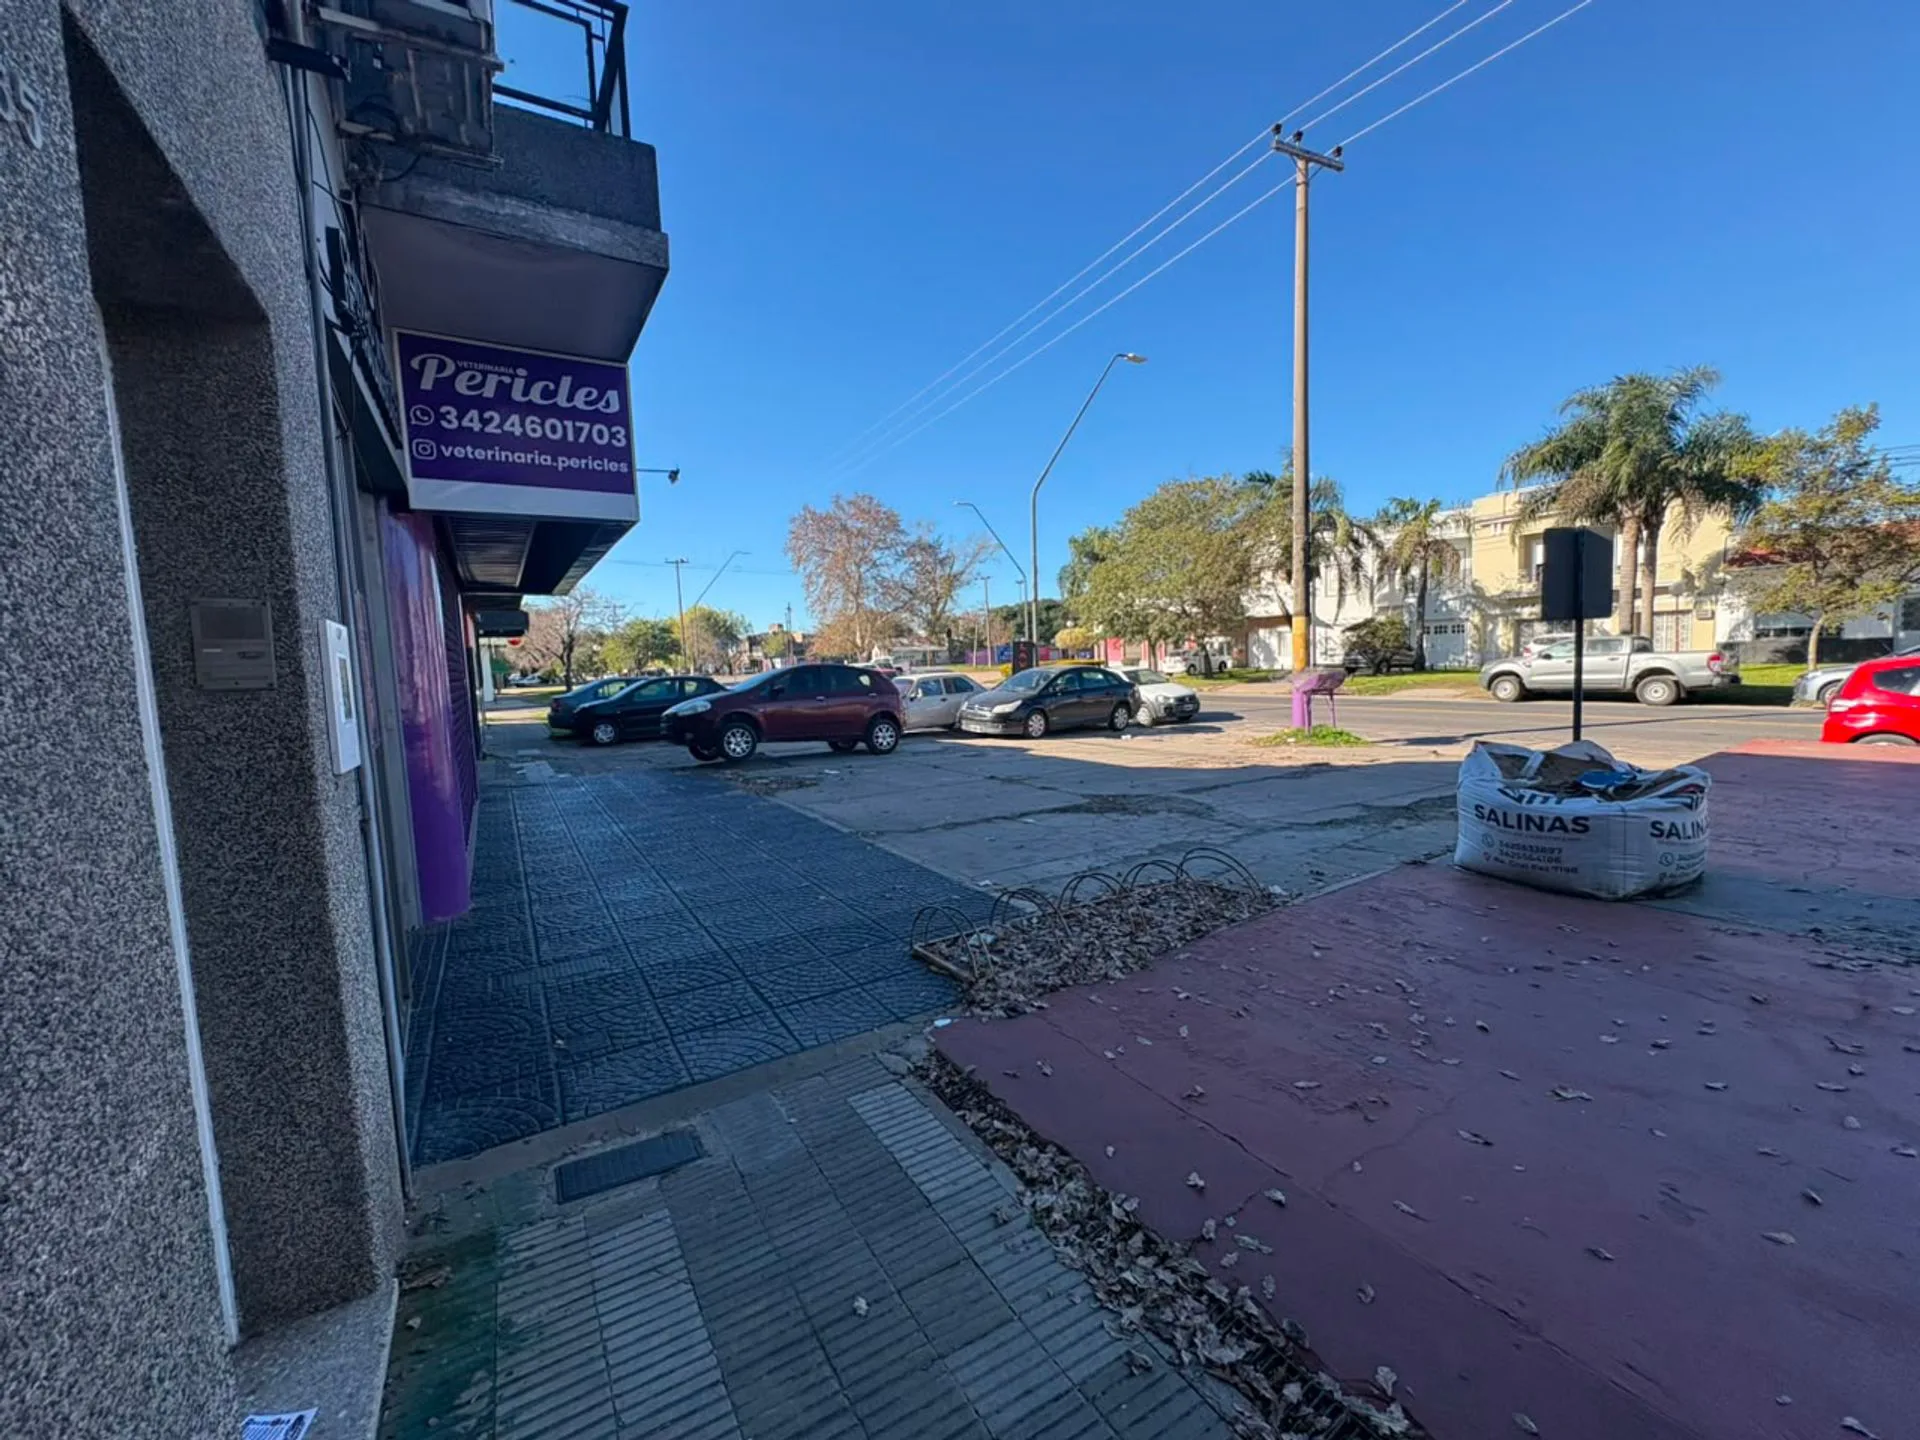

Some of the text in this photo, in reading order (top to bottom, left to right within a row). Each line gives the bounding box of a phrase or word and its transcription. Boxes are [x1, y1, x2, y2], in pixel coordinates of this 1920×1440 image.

[456, 360, 515, 374] VETERINARIA
[410, 353, 620, 413] Pericles
[439, 405, 627, 447] 3424601703
[440, 443, 628, 472] veterinaria.pericles
[1474, 803, 1590, 834] SALINAS
